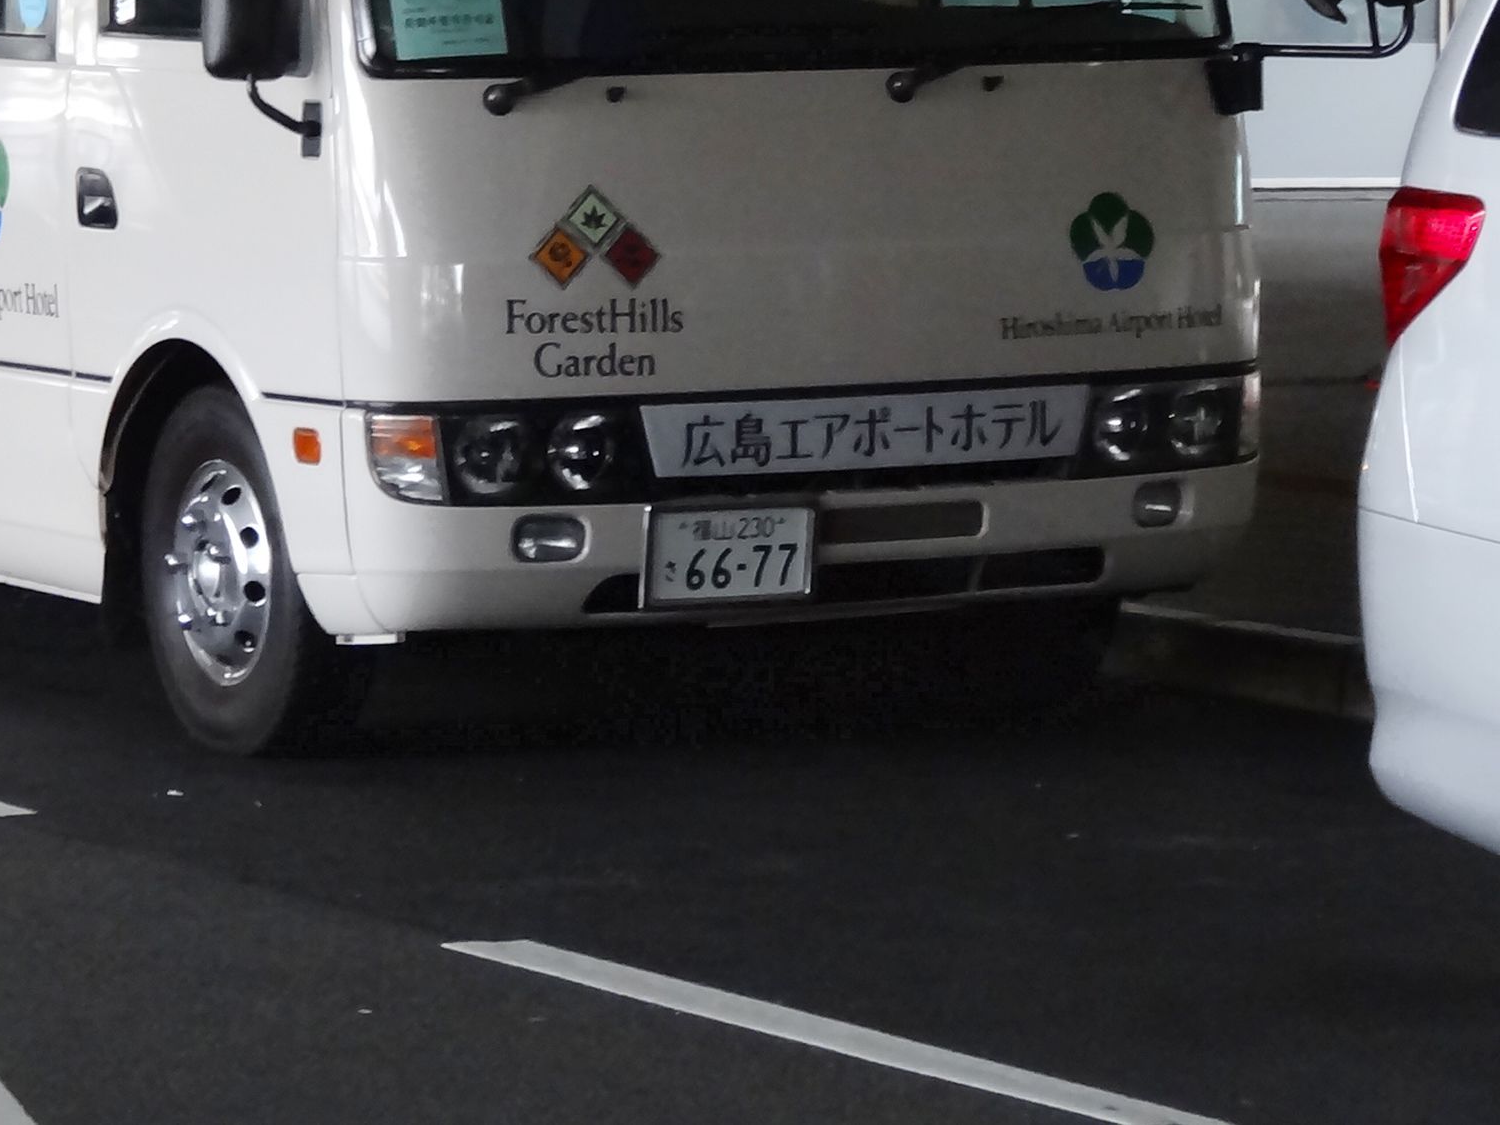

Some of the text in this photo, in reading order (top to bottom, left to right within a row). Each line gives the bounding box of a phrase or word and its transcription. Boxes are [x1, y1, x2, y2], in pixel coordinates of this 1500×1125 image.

[24, 282, 60, 319] Hotel
[533, 341, 657, 378] Garden
[681, 400, 1063, 468] 広島エアポートホテル
[685, 542, 799, 592] 66-77
